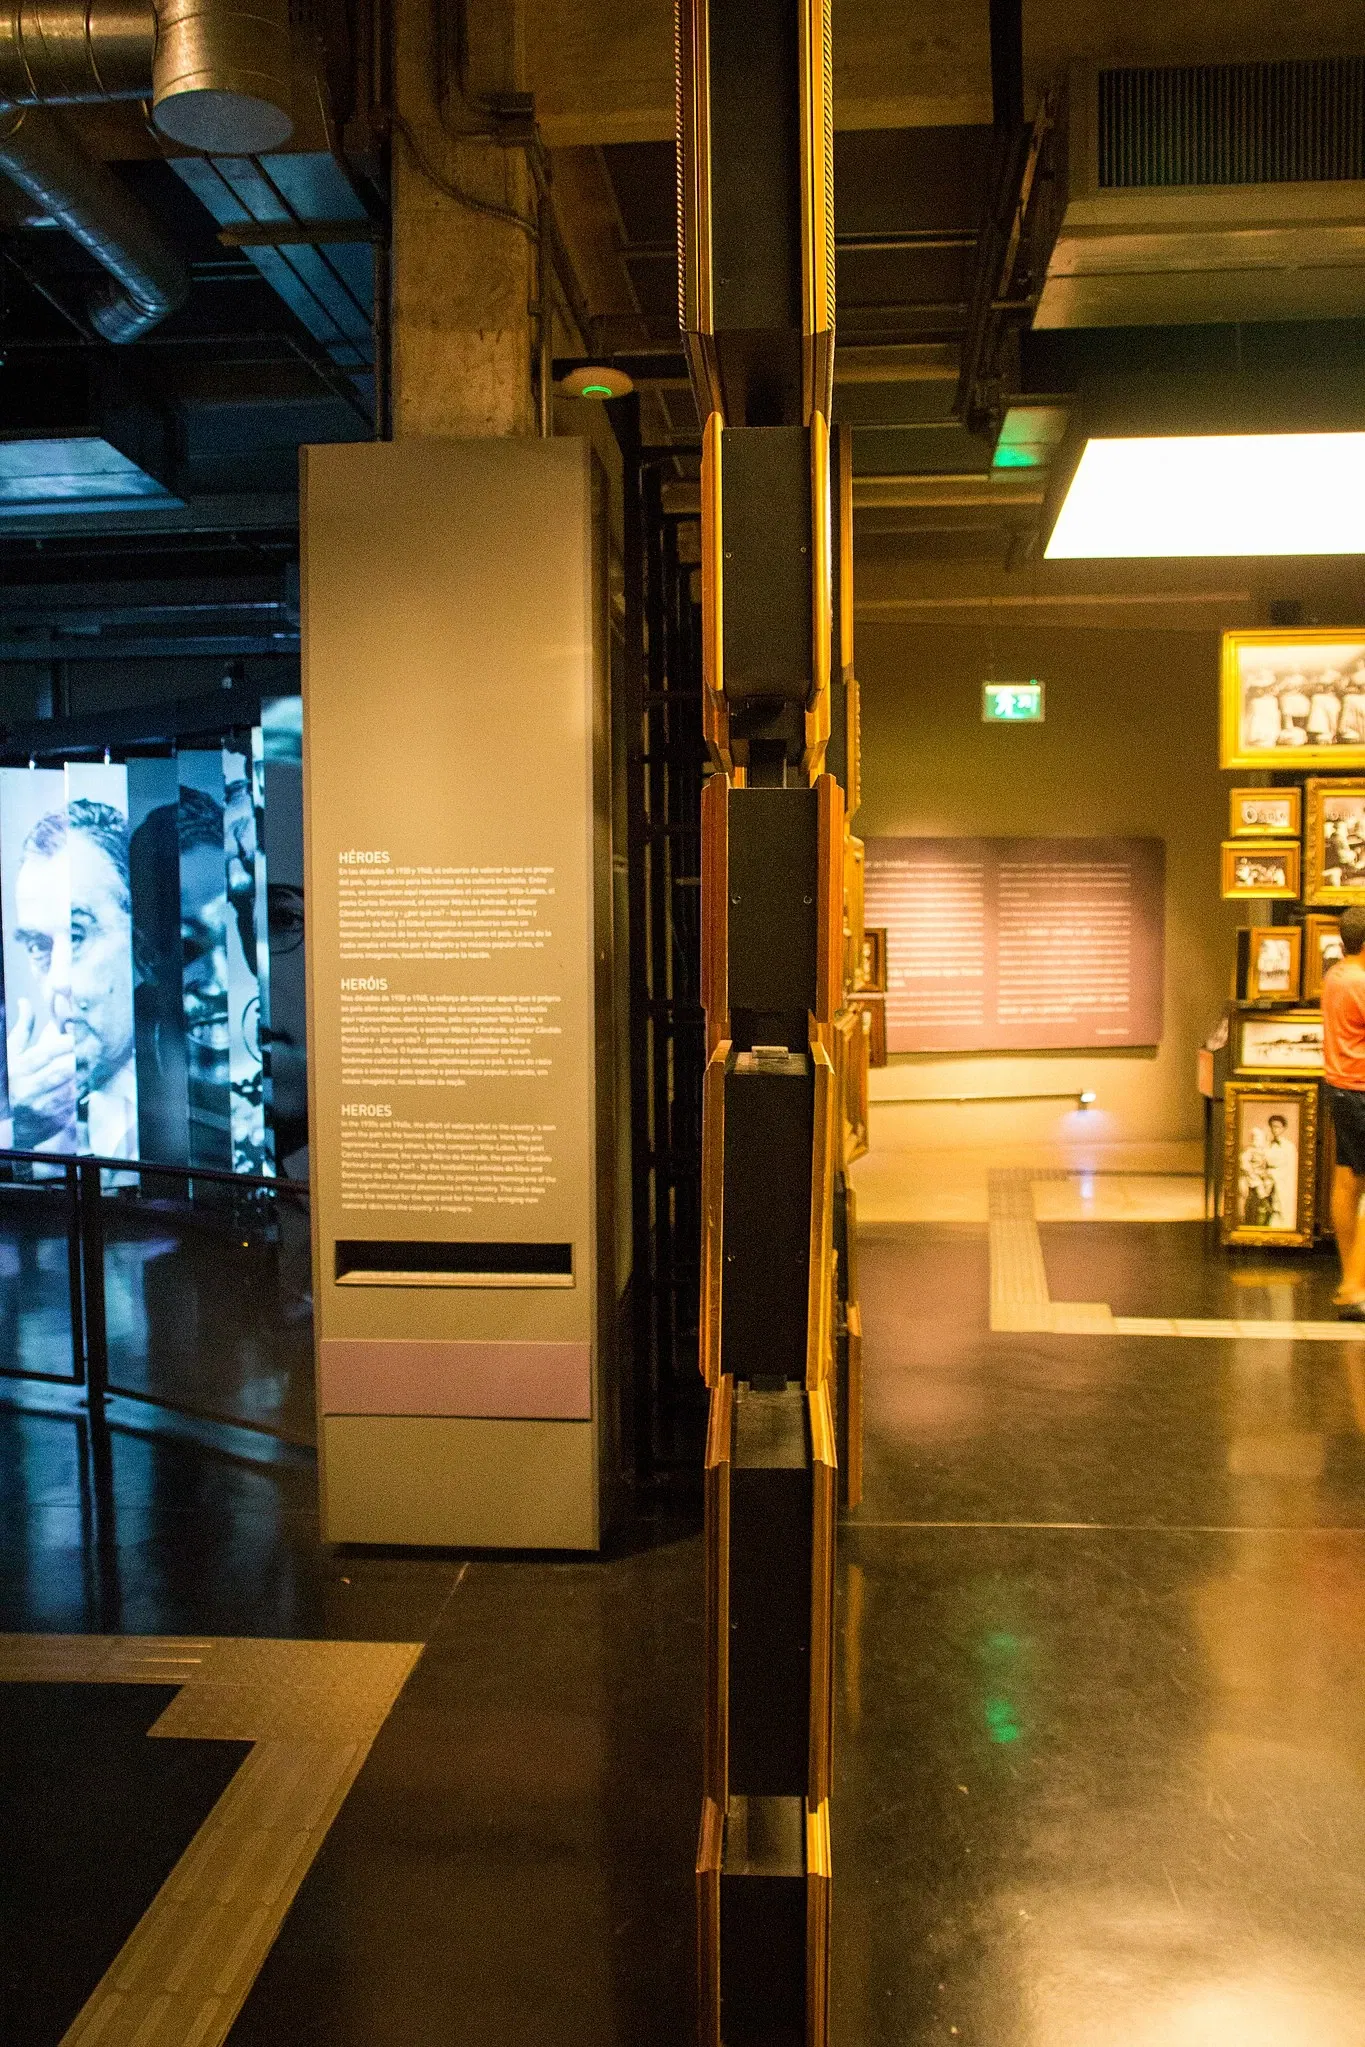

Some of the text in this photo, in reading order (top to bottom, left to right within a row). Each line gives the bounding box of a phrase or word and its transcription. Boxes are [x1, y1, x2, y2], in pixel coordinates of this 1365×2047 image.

[338, 848, 390, 864] HÉROES
[340, 975, 388, 991] HERÓIS
[341, 1104, 392, 1117] HEROES
